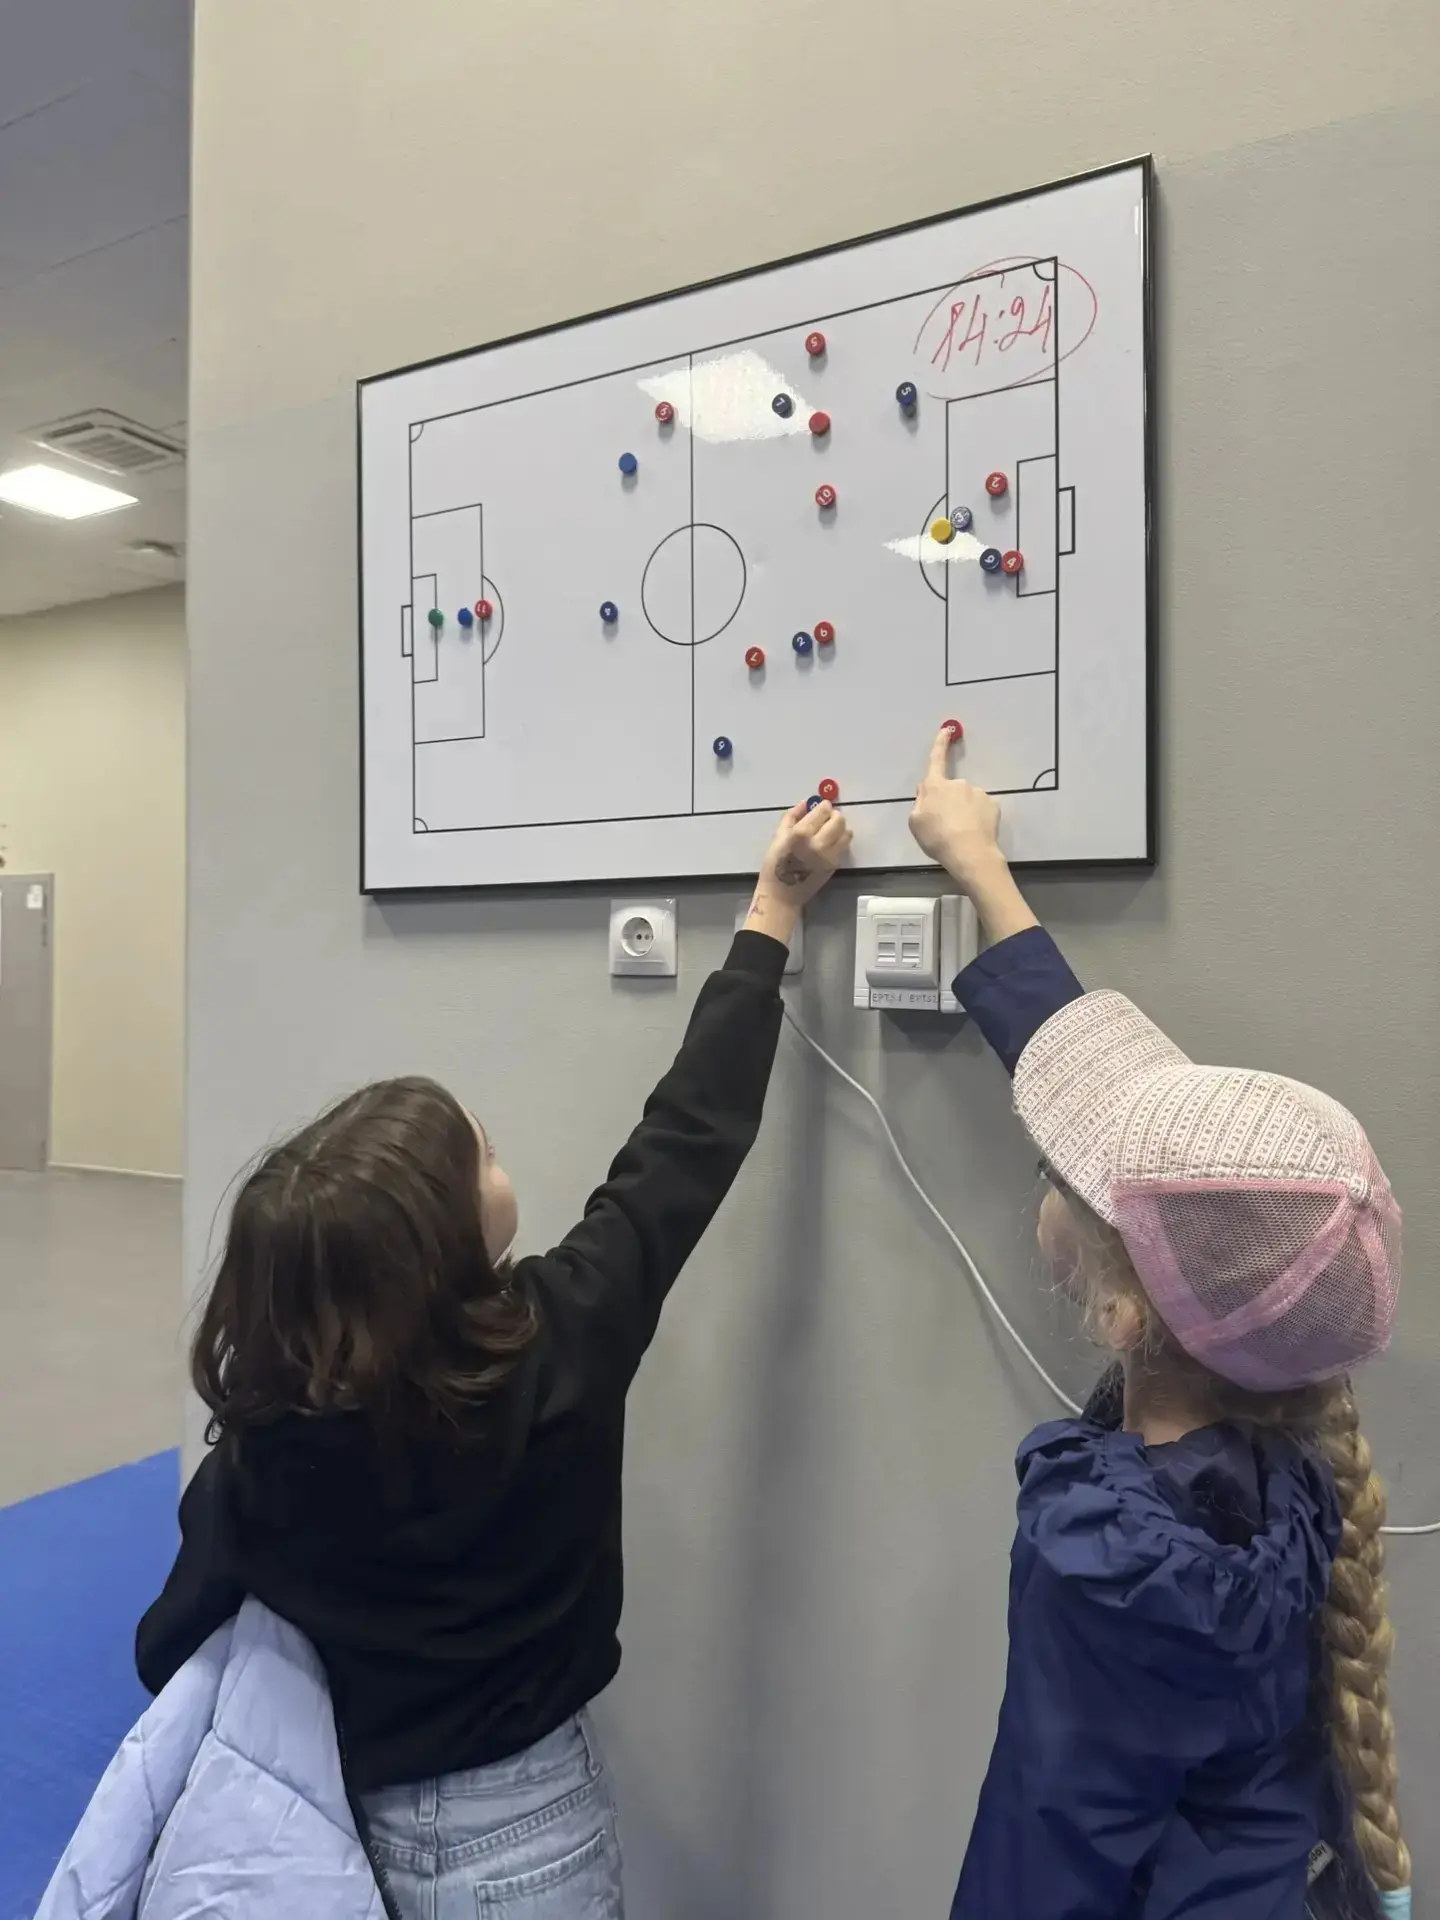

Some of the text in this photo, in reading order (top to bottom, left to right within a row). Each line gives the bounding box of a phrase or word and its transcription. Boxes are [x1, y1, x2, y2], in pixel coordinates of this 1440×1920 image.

[901, 386, 911, 395] 5
[776, 397, 785, 406] 7
[1007, 557, 1016, 568] 4
[796, 636, 805, 647] 2
